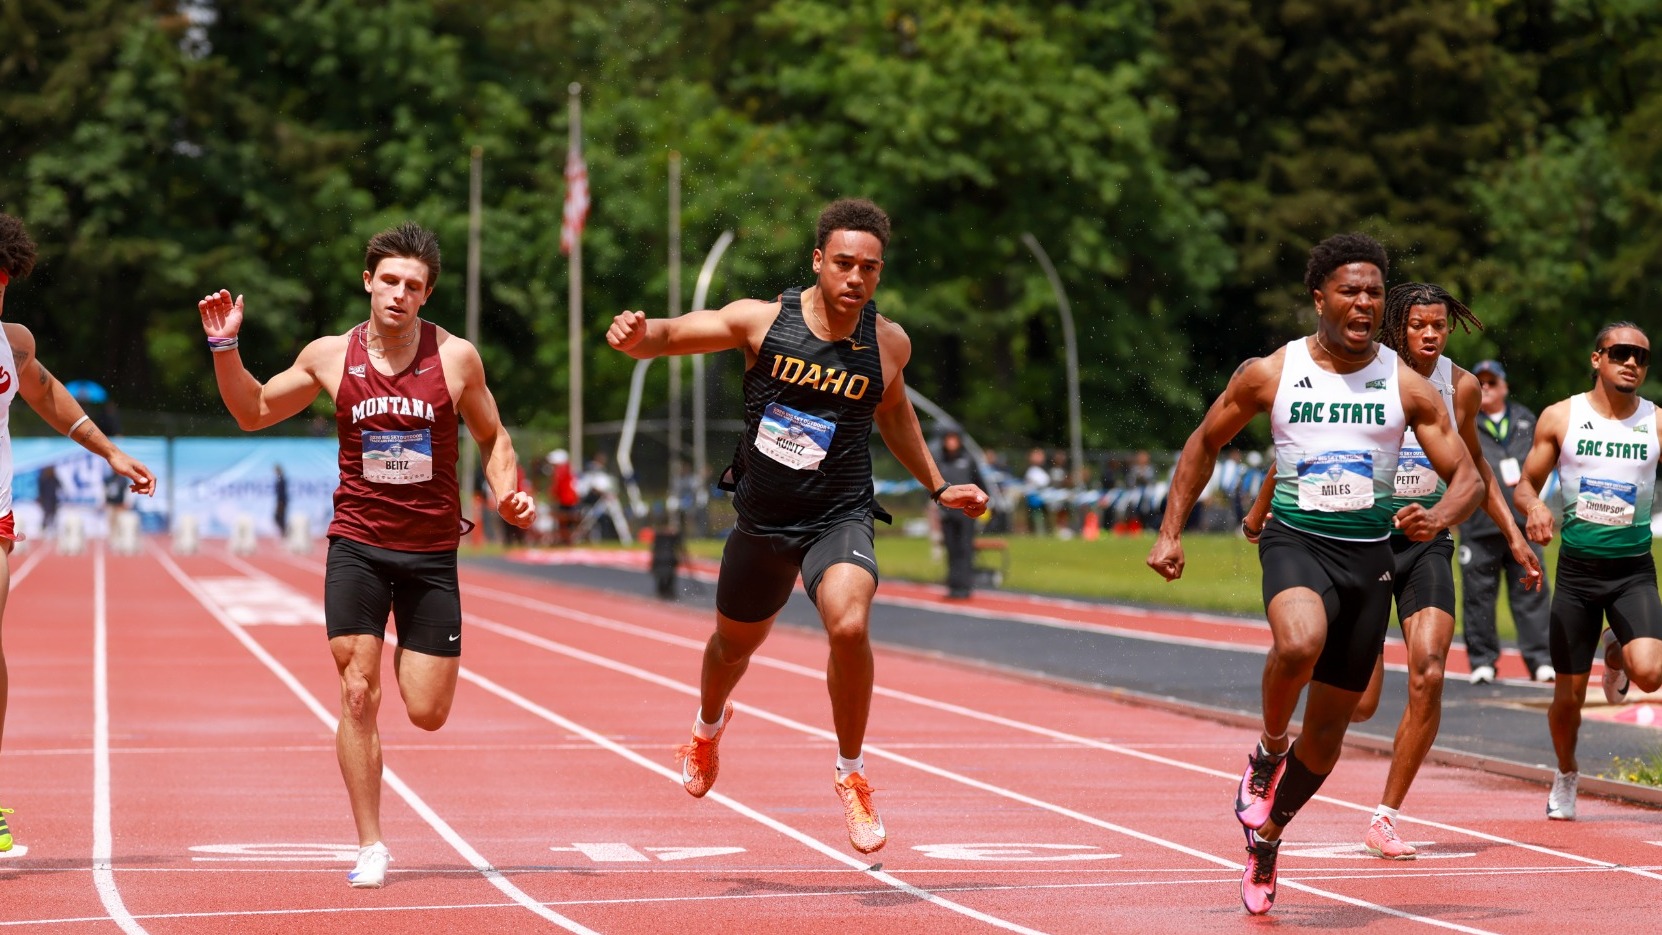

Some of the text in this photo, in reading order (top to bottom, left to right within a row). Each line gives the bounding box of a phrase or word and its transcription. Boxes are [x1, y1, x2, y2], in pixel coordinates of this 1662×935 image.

[770, 354, 870, 400] IDAHO
[351, 396, 436, 425] MONTANA
[1288, 401, 1386, 426] SAC STATE
[776, 437, 806, 456] KUNTZ
[1576, 439, 1647, 460] SAC STATE
[385, 460, 409, 470] BEITZ
[1396, 475, 1420, 485] PETTY
[1321, 484, 1351, 496] MILES
[1586, 501, 1625, 516] THOMPSON
